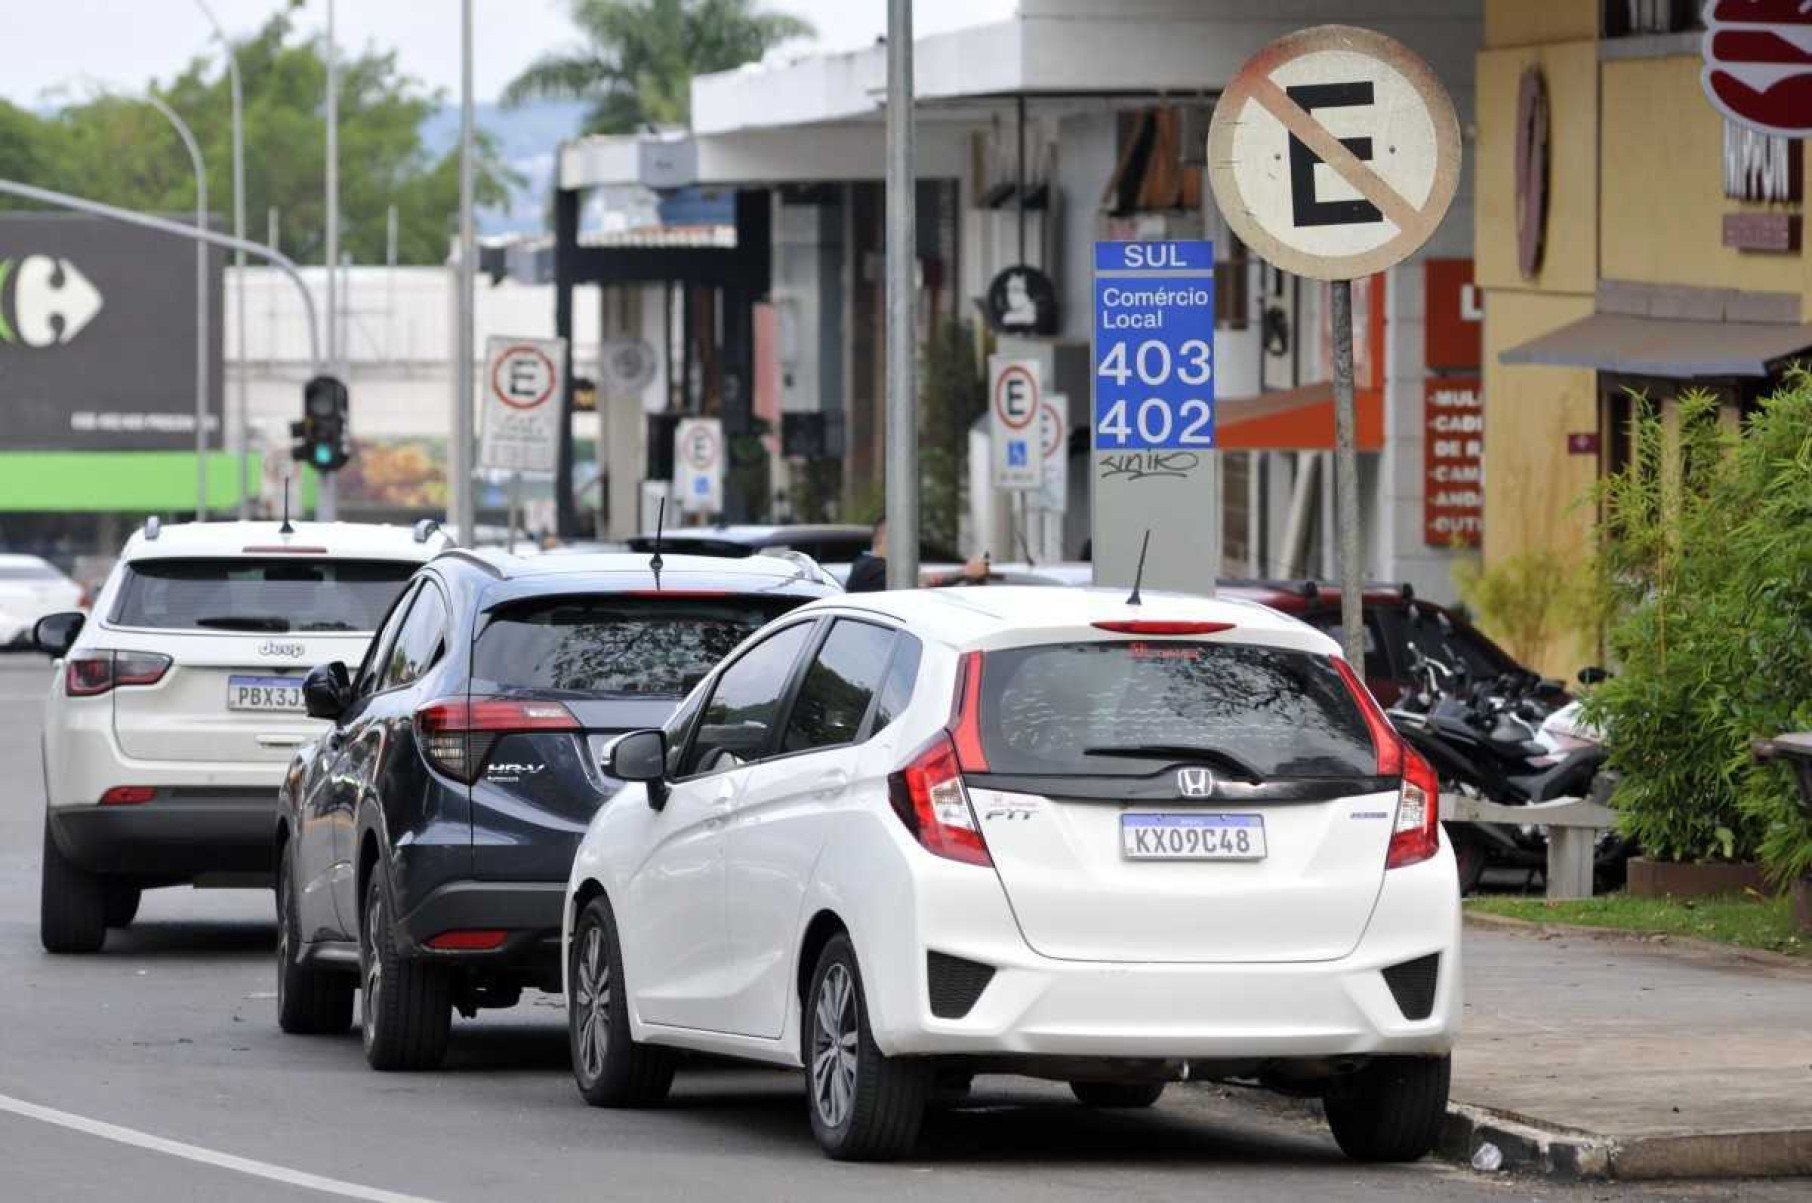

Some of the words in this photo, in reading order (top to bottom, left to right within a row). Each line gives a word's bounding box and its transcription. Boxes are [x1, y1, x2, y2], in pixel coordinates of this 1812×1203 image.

[1286, 81, 1383, 227] E
[1124, 243, 1187, 268] SUL
[1102, 286, 1209, 307] Comércio
[1103, 309, 1162, 329] Local
[511, 360, 538, 395] E
[1098, 339, 1211, 386] 403
[1007, 379, 1024, 416] E
[1098, 398, 1212, 444] 402
[239, 686, 307, 707] PBX3J
